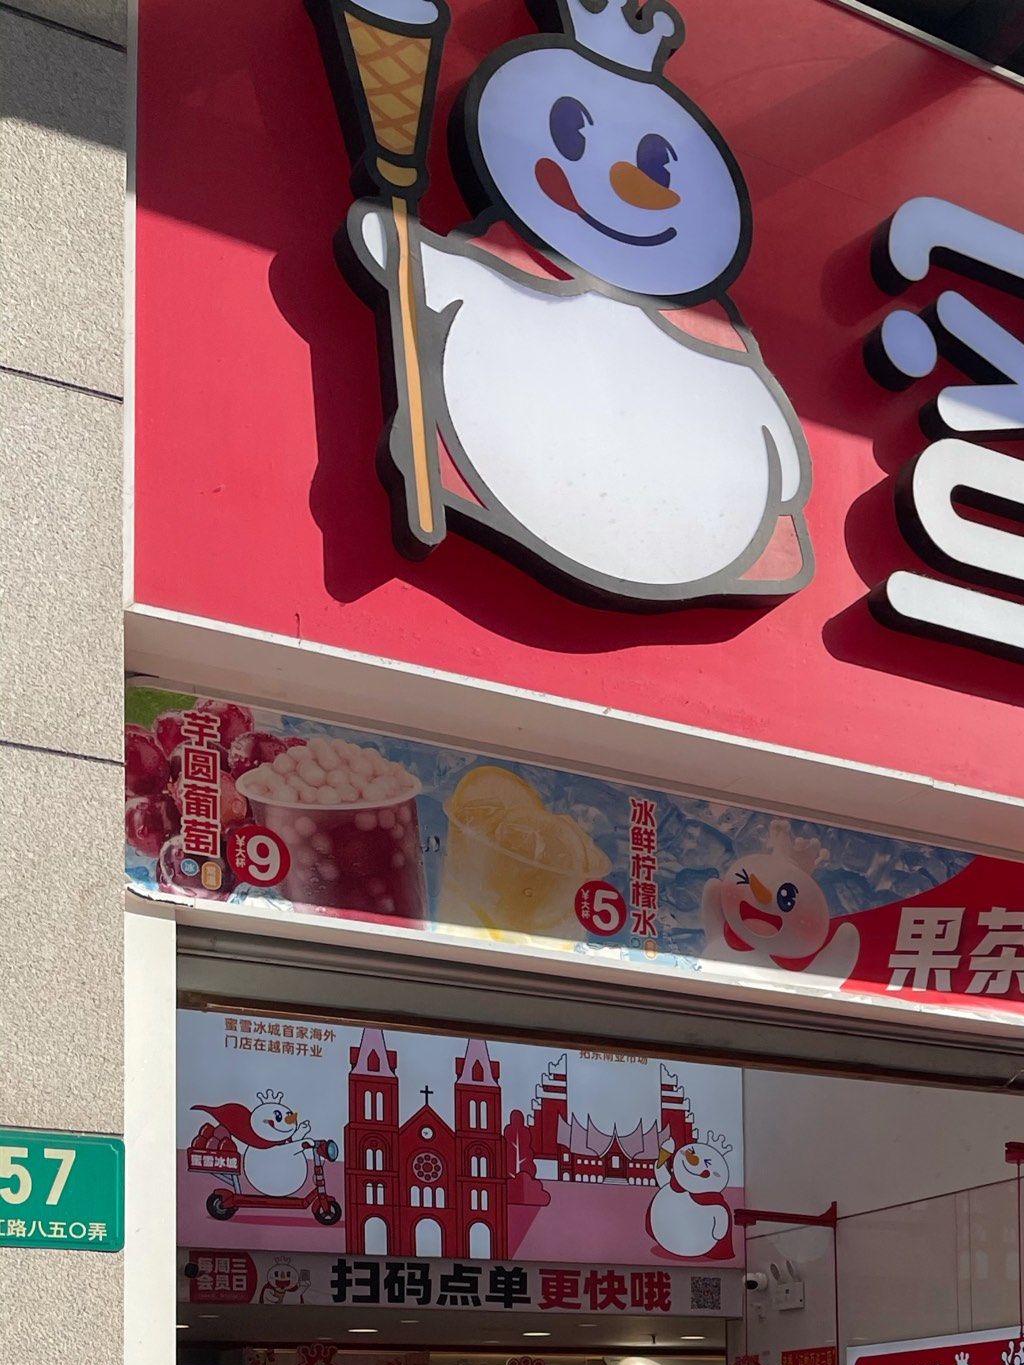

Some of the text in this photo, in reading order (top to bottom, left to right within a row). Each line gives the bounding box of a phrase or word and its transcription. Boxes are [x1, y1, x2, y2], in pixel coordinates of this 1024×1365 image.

[181, 711, 221, 858] 芋圆葡萄
[629, 797, 657, 937] 冰鲜柠檬水
[224, 1017, 336, 1043] 蜜雪冰城首家海外
[224, 1035, 324, 1058] 门店在越南开业
[330, 1258, 673, 1312] 扫码点单更快哦
